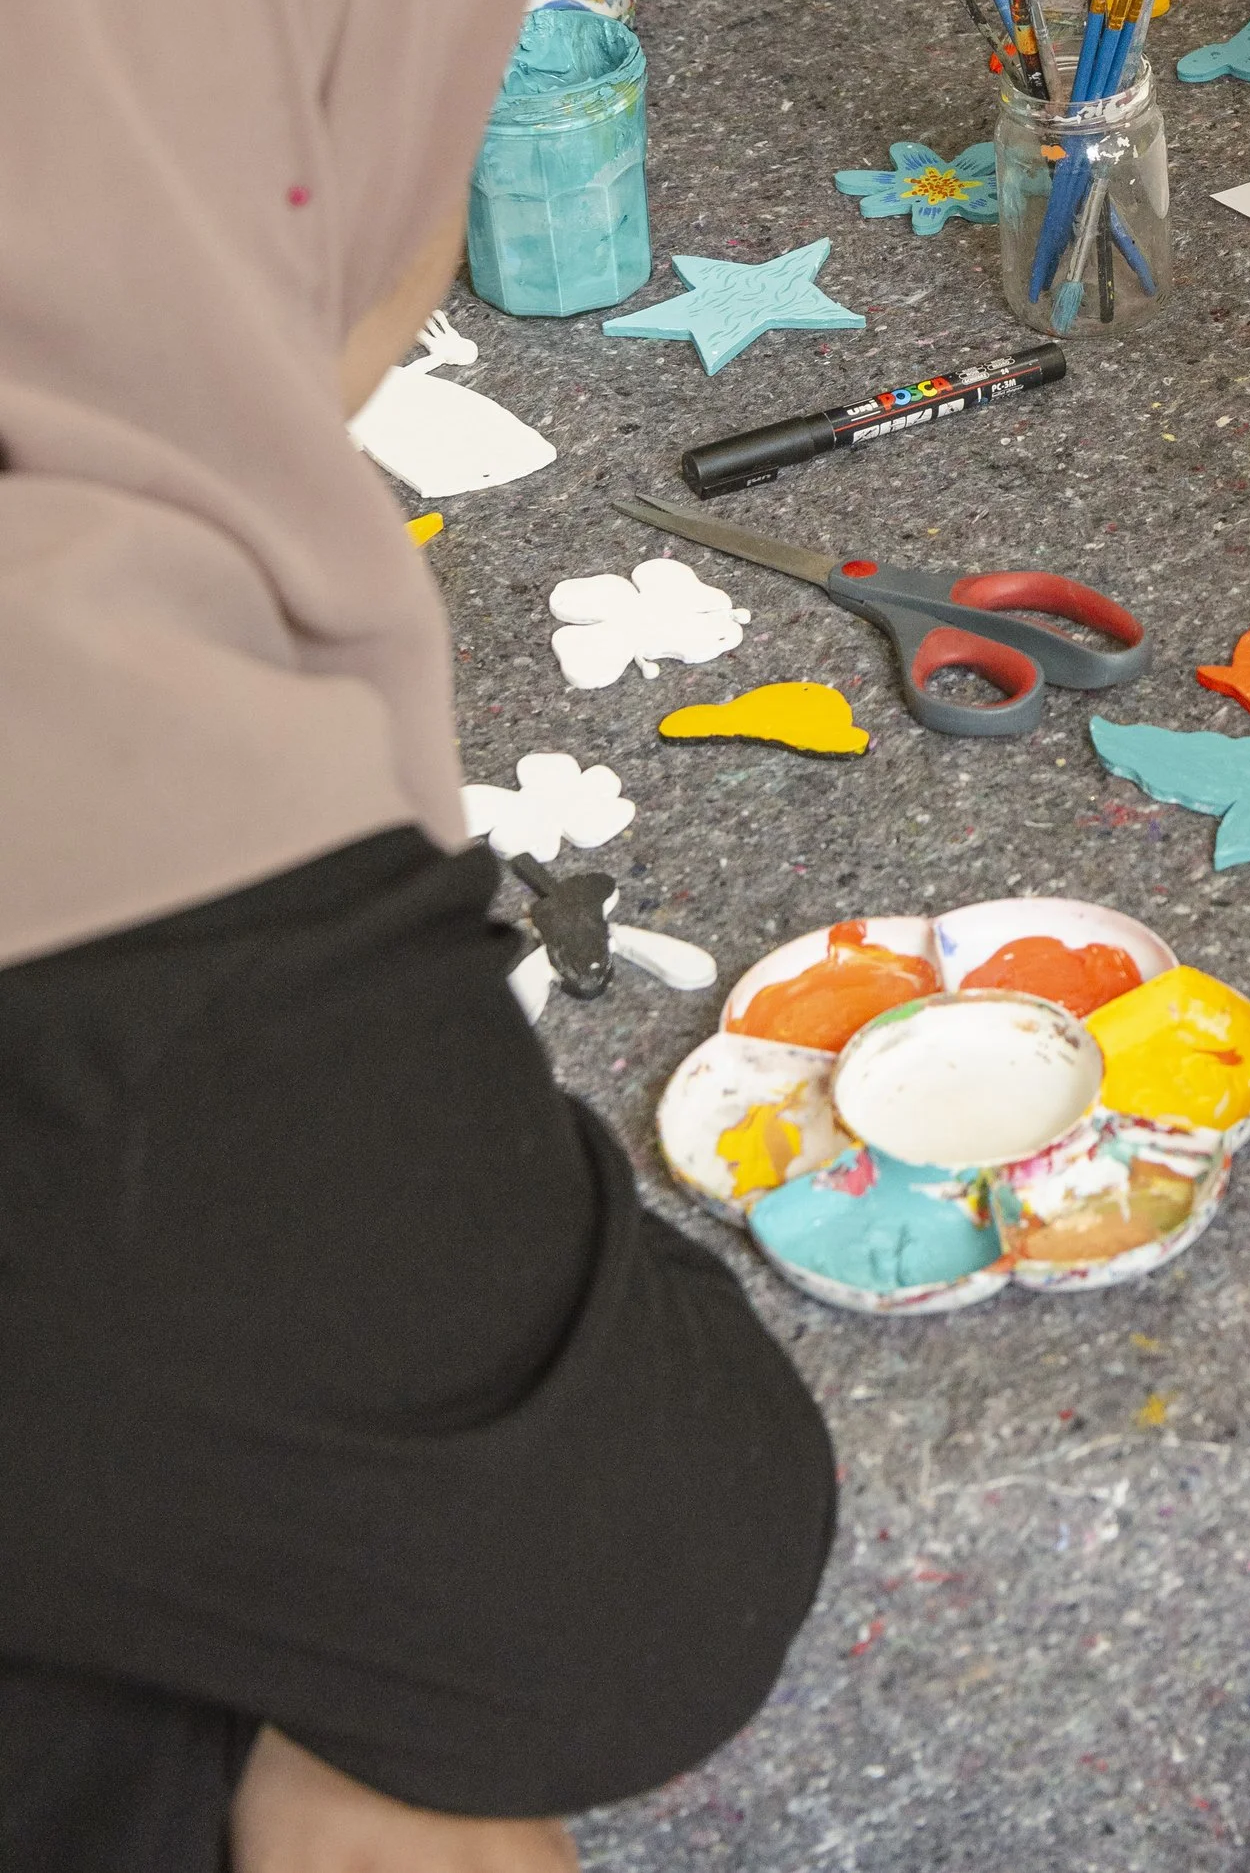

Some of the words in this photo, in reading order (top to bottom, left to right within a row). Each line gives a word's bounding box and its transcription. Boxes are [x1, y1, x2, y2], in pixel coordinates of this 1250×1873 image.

[846, 398, 879, 416] uni
[877, 375, 954, 411] POSCA
[991, 378, 1016, 393] PC-3M
